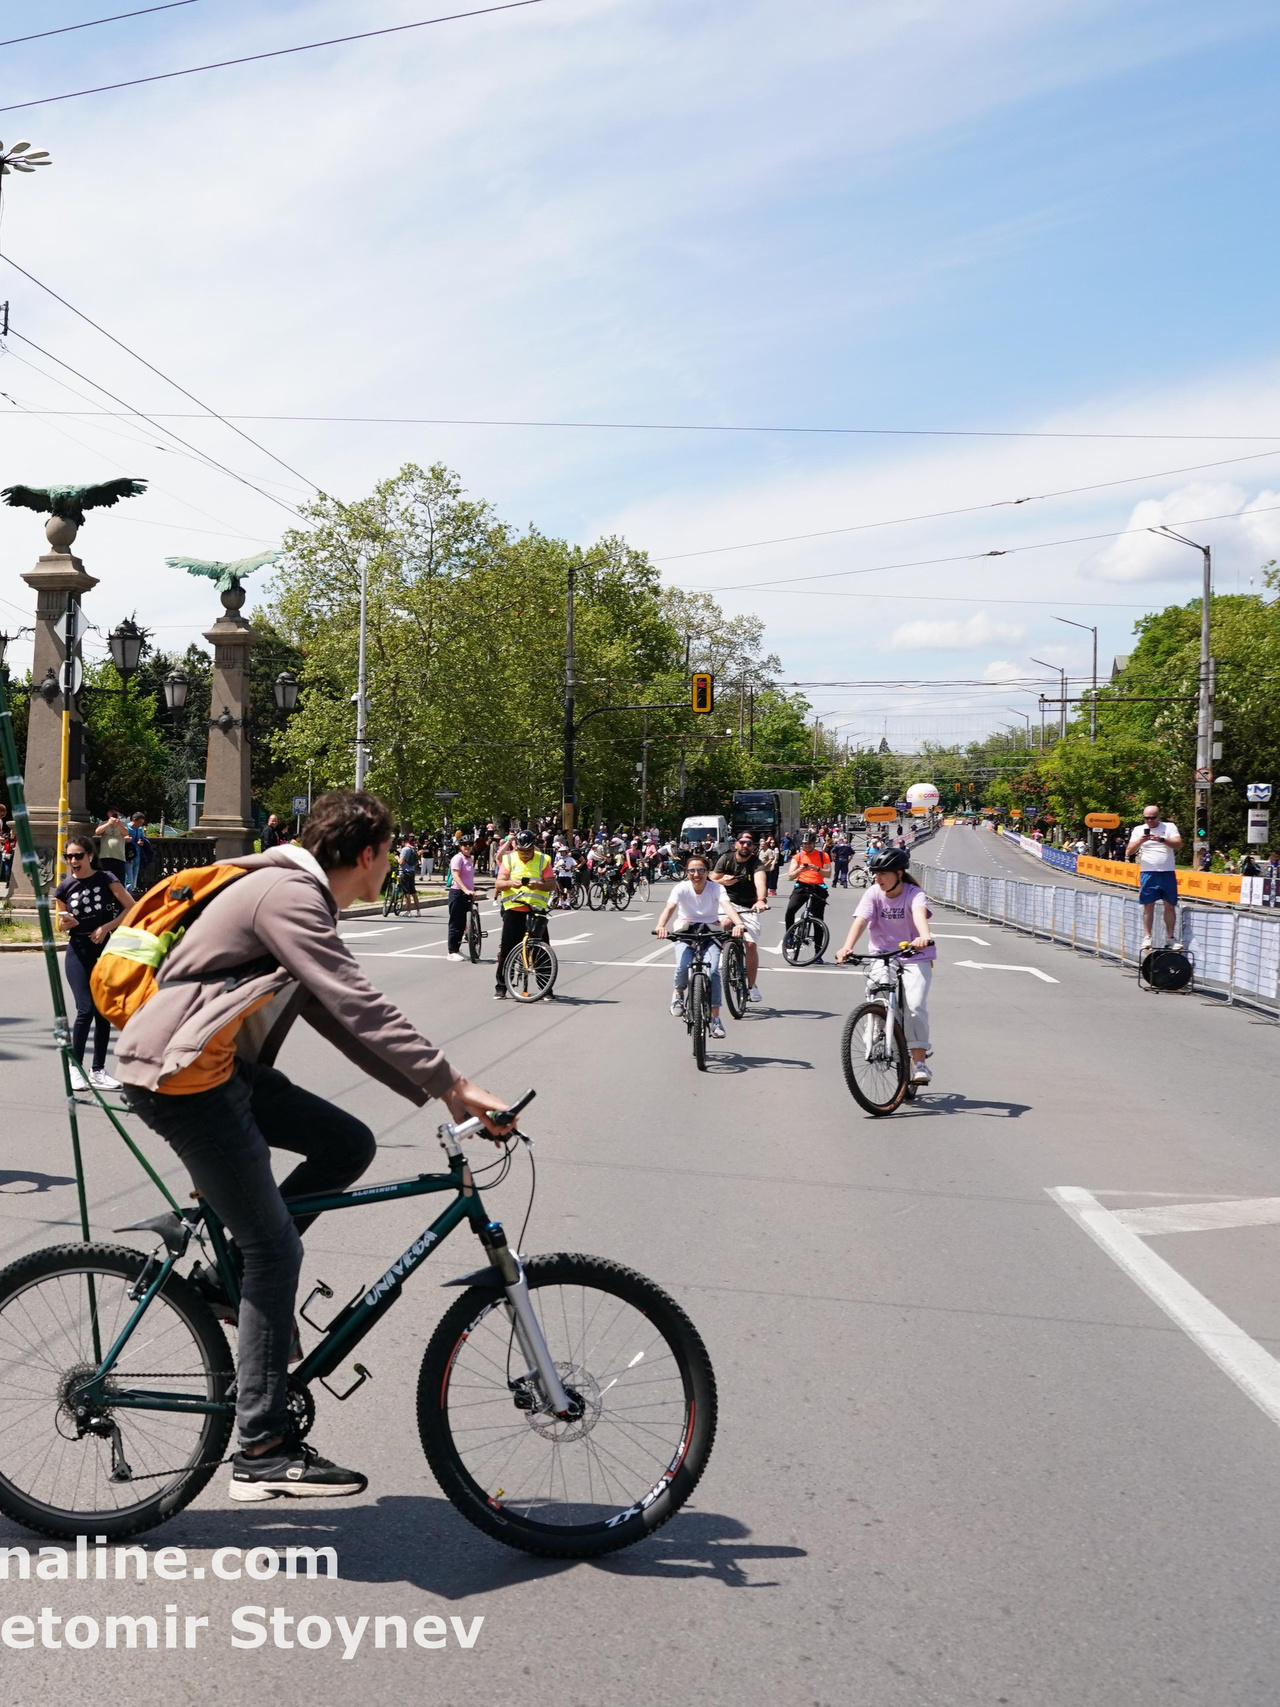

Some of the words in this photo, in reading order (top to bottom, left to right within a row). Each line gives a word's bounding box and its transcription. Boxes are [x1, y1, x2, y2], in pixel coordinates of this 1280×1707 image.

[351, 1185, 398, 1197] ALUMINUM
[364, 1230, 438, 1306] UNIVEGA
[604, 1506, 641, 1528] ZX
